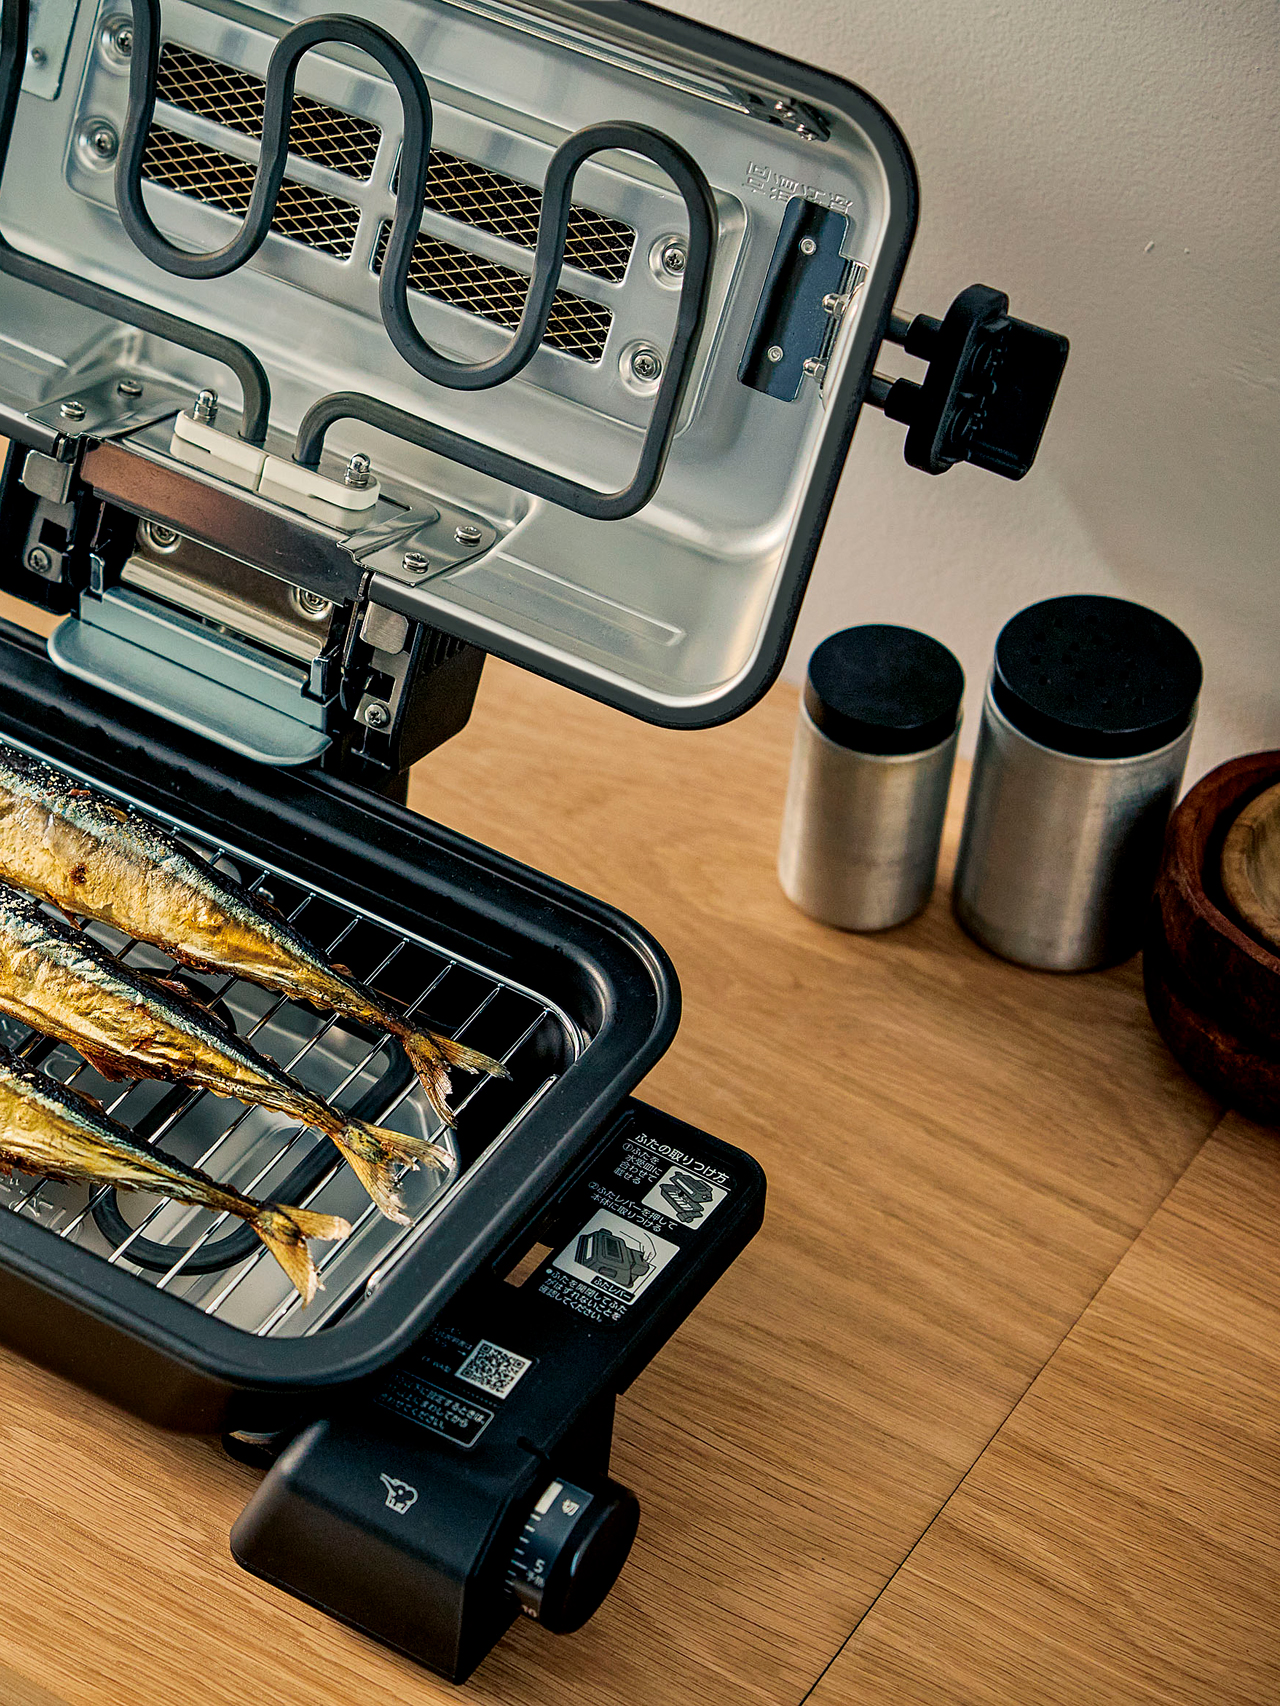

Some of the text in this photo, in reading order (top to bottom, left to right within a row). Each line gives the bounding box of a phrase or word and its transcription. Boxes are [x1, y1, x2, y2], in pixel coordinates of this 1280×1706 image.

[624, 1153, 662, 1177] 水受皿に
[634, 1132, 729, 1184] ふたの取りつけ方
[614, 1167, 642, 1185] 載せる
[619, 1162, 657, 1183] 合わせて
[591, 1192, 662, 1232] 本体に取りつける
[544, 1277, 621, 1321] がはずれないことを
[595, 1277, 632, 1299] ふたレバー
[538, 1285, 603, 1323] 確認してください。
[534, 1558, 545, 1574] 5
